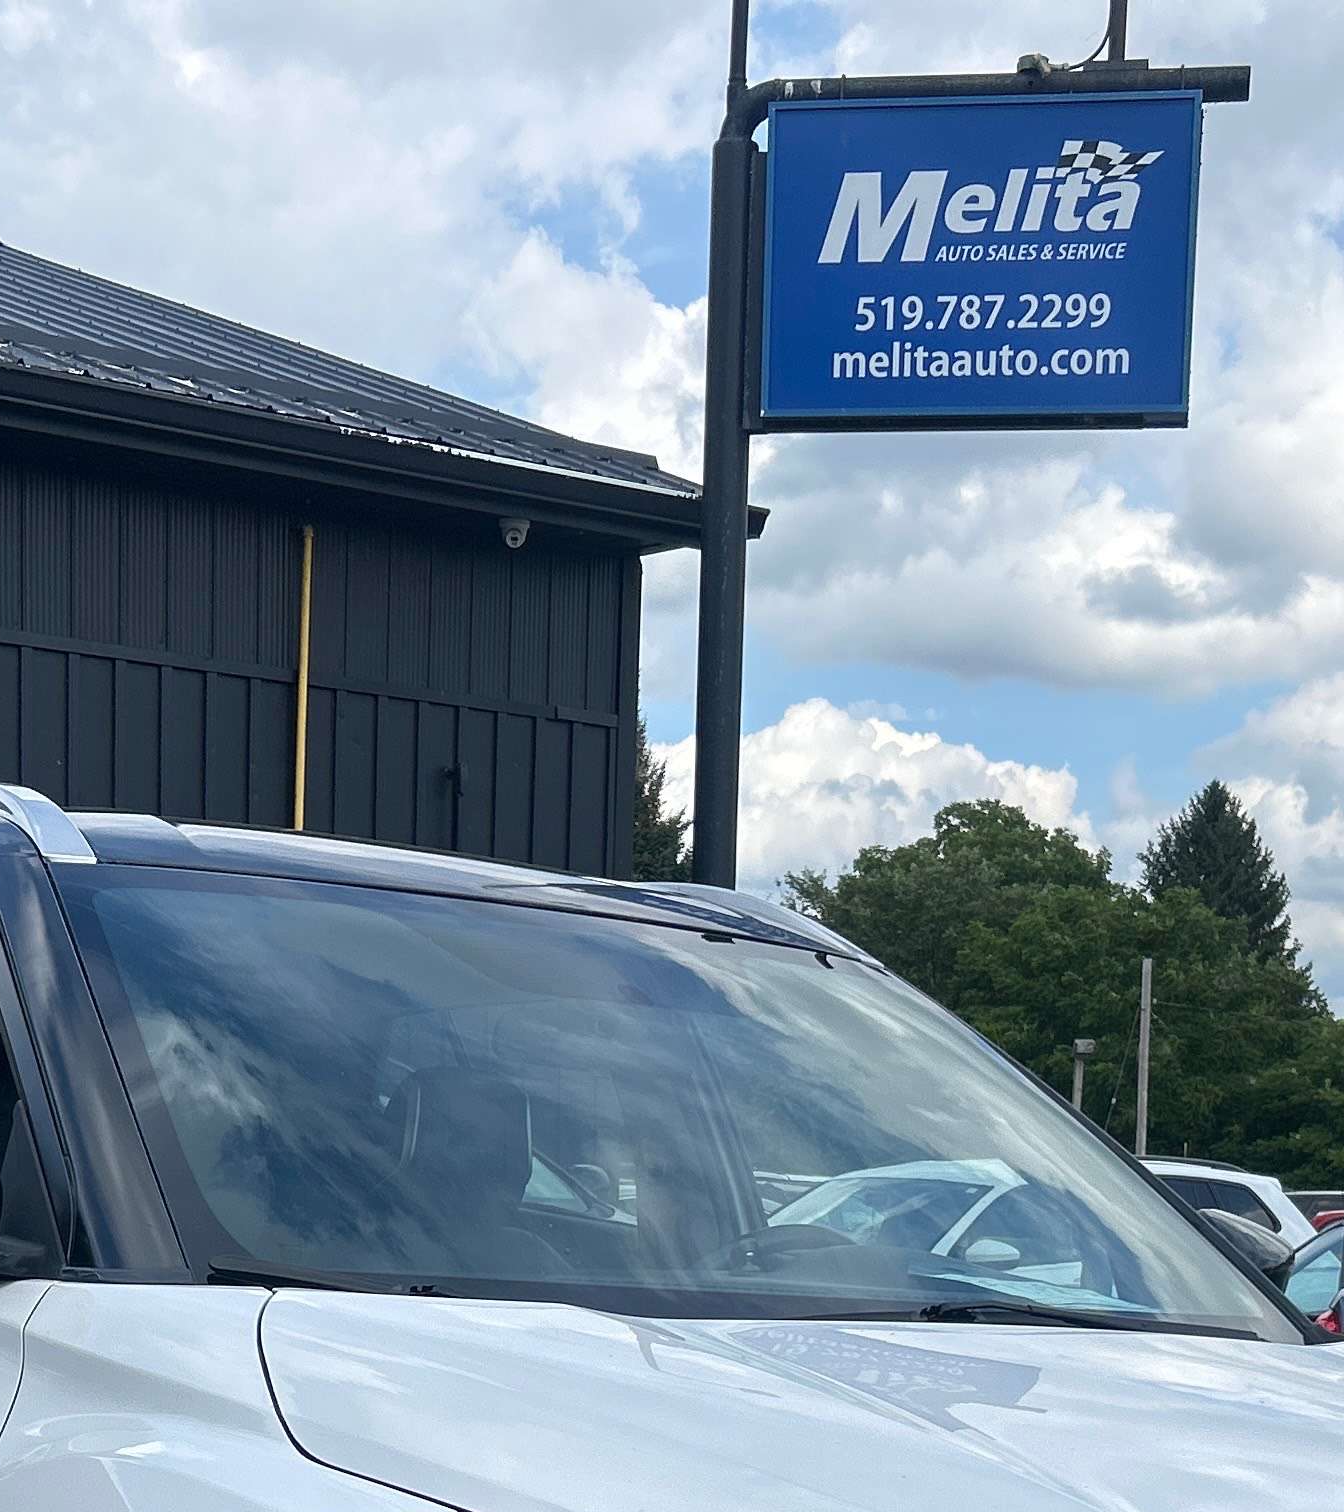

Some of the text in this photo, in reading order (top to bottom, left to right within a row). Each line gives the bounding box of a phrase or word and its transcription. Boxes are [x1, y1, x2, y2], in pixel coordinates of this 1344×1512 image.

[817, 164, 1142, 264] Melita
[934, 241, 1127, 262] AUTO SALES & SERVICE
[855, 293, 1111, 331] 519.787.2299
[833, 341, 1130, 378] melitaauto.com
